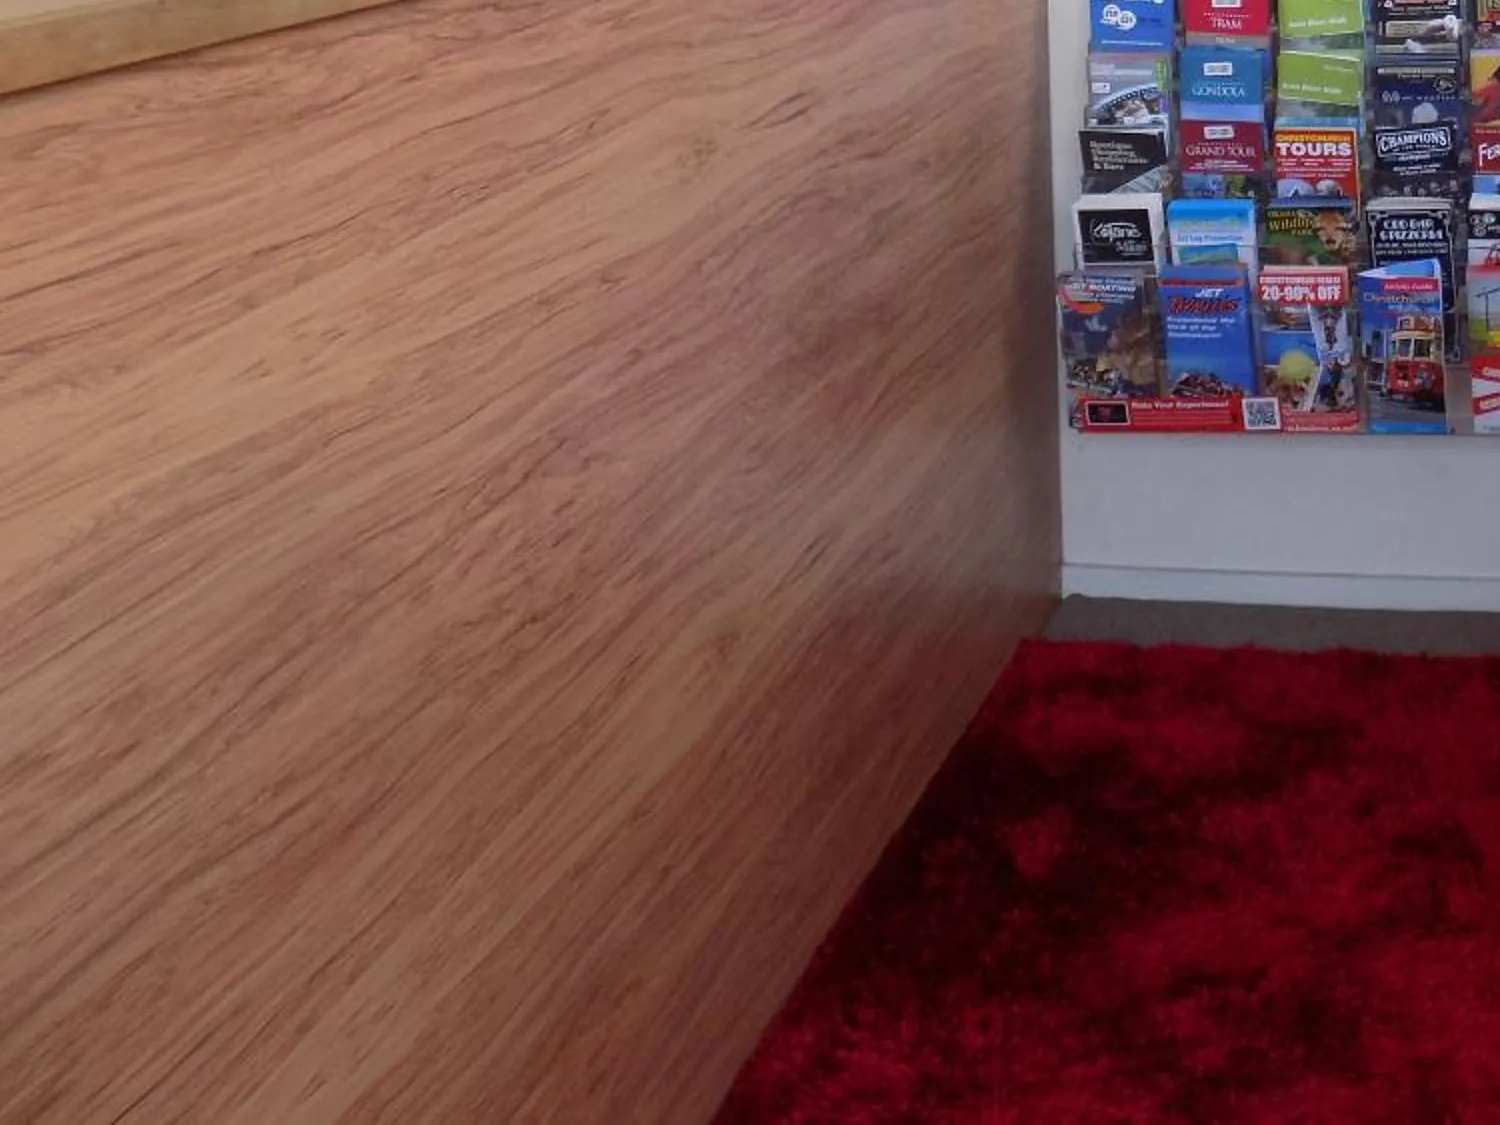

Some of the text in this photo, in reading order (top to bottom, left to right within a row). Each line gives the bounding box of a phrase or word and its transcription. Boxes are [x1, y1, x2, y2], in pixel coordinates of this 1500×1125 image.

[1210, 17, 1243, 30] TRAM
[1190, 84, 1246, 97] GONDOLA
[1380, 130, 1448, 152] CHAMPIONS
[1185, 144, 1256, 157] GRAND TOUR
[1276, 142, 1352, 157] TOURS
[1195, 288, 1224, 298] JET
[1317, 284, 1342, 301] OFF
